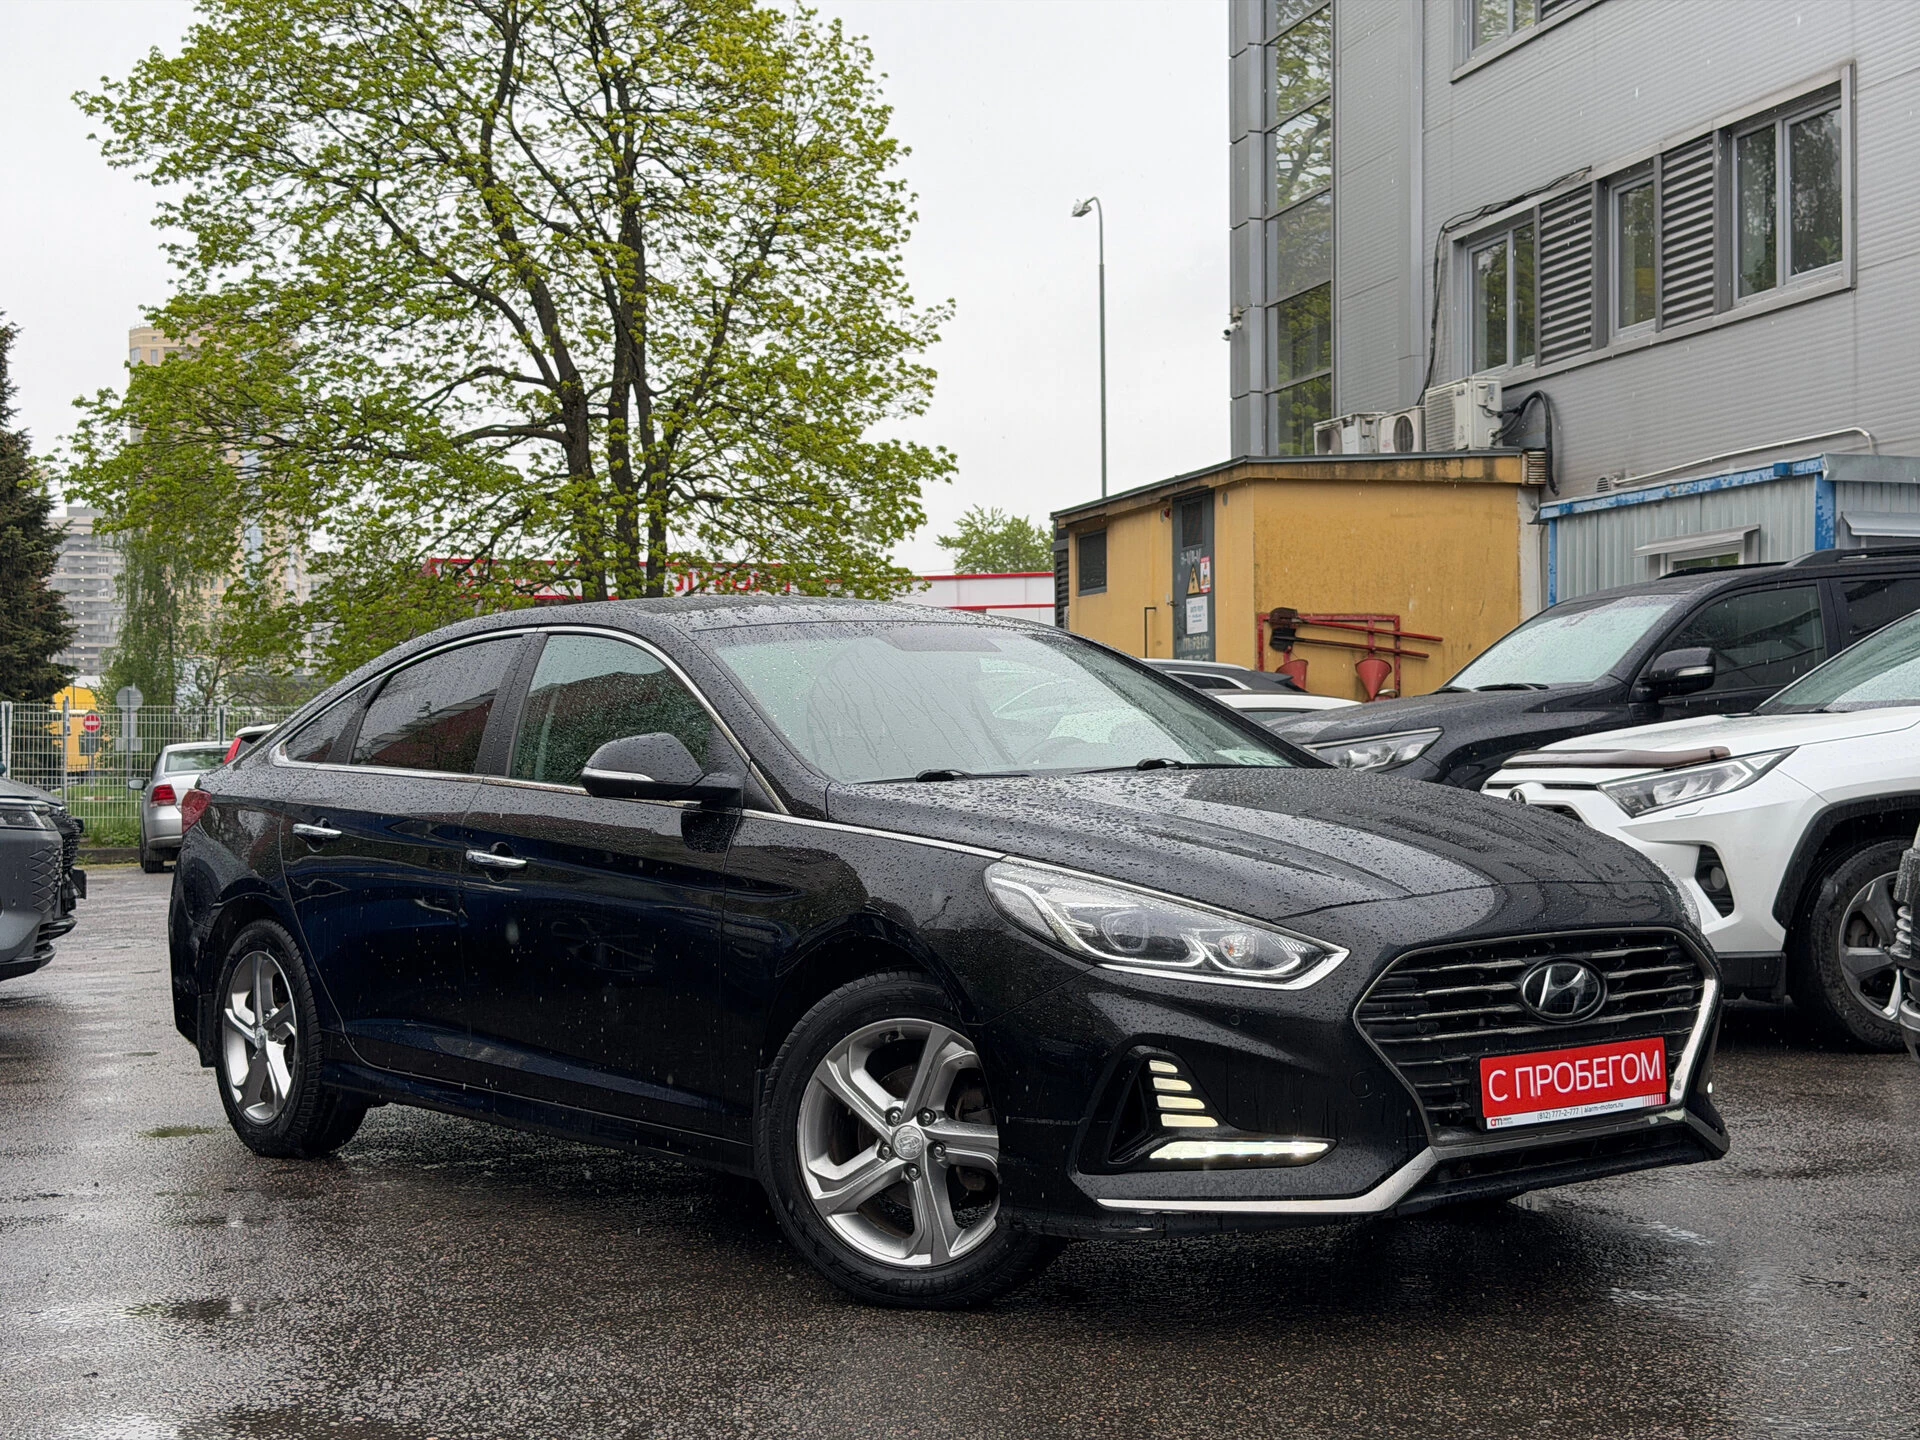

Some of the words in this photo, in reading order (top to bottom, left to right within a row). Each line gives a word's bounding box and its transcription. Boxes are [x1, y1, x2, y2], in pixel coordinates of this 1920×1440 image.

[1488, 1069, 1508, 1102] С
[1514, 1049, 1661, 1099] ПРОБЕГОМ
[1537, 1112, 1551, 1121] (812)
[1552, 1107, 1579, 1118] 777-2-777
[1584, 1102, 1624, 1113] alarm-motors.ru
